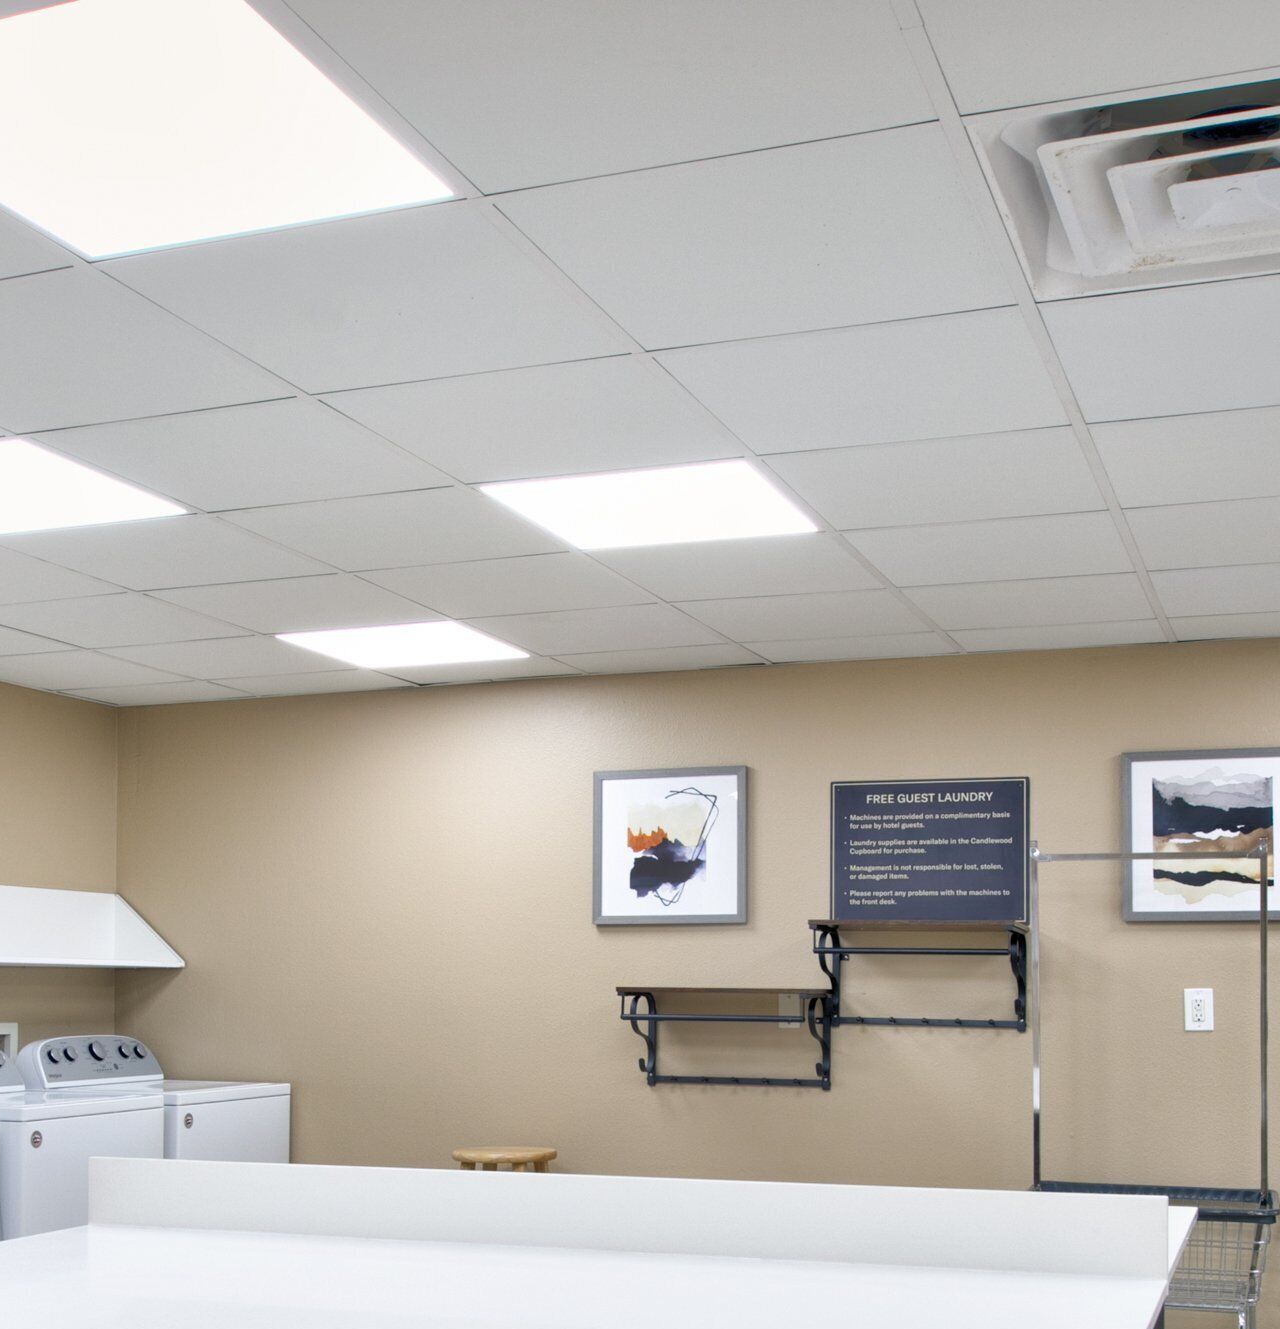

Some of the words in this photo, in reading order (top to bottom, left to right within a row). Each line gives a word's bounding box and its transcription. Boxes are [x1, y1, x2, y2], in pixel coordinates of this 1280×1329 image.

[866, 794, 895, 804] FREE
[897, 793, 935, 804] GUEST
[938, 792, 993, 802] LAUNDRY
[895, 813, 923, 821] provided
[941, 812, 991, 820] complimentary
[901, 822, 925, 830] guests.
[913, 863, 951, 871] responsible
[858, 873, 887, 881] damaged
